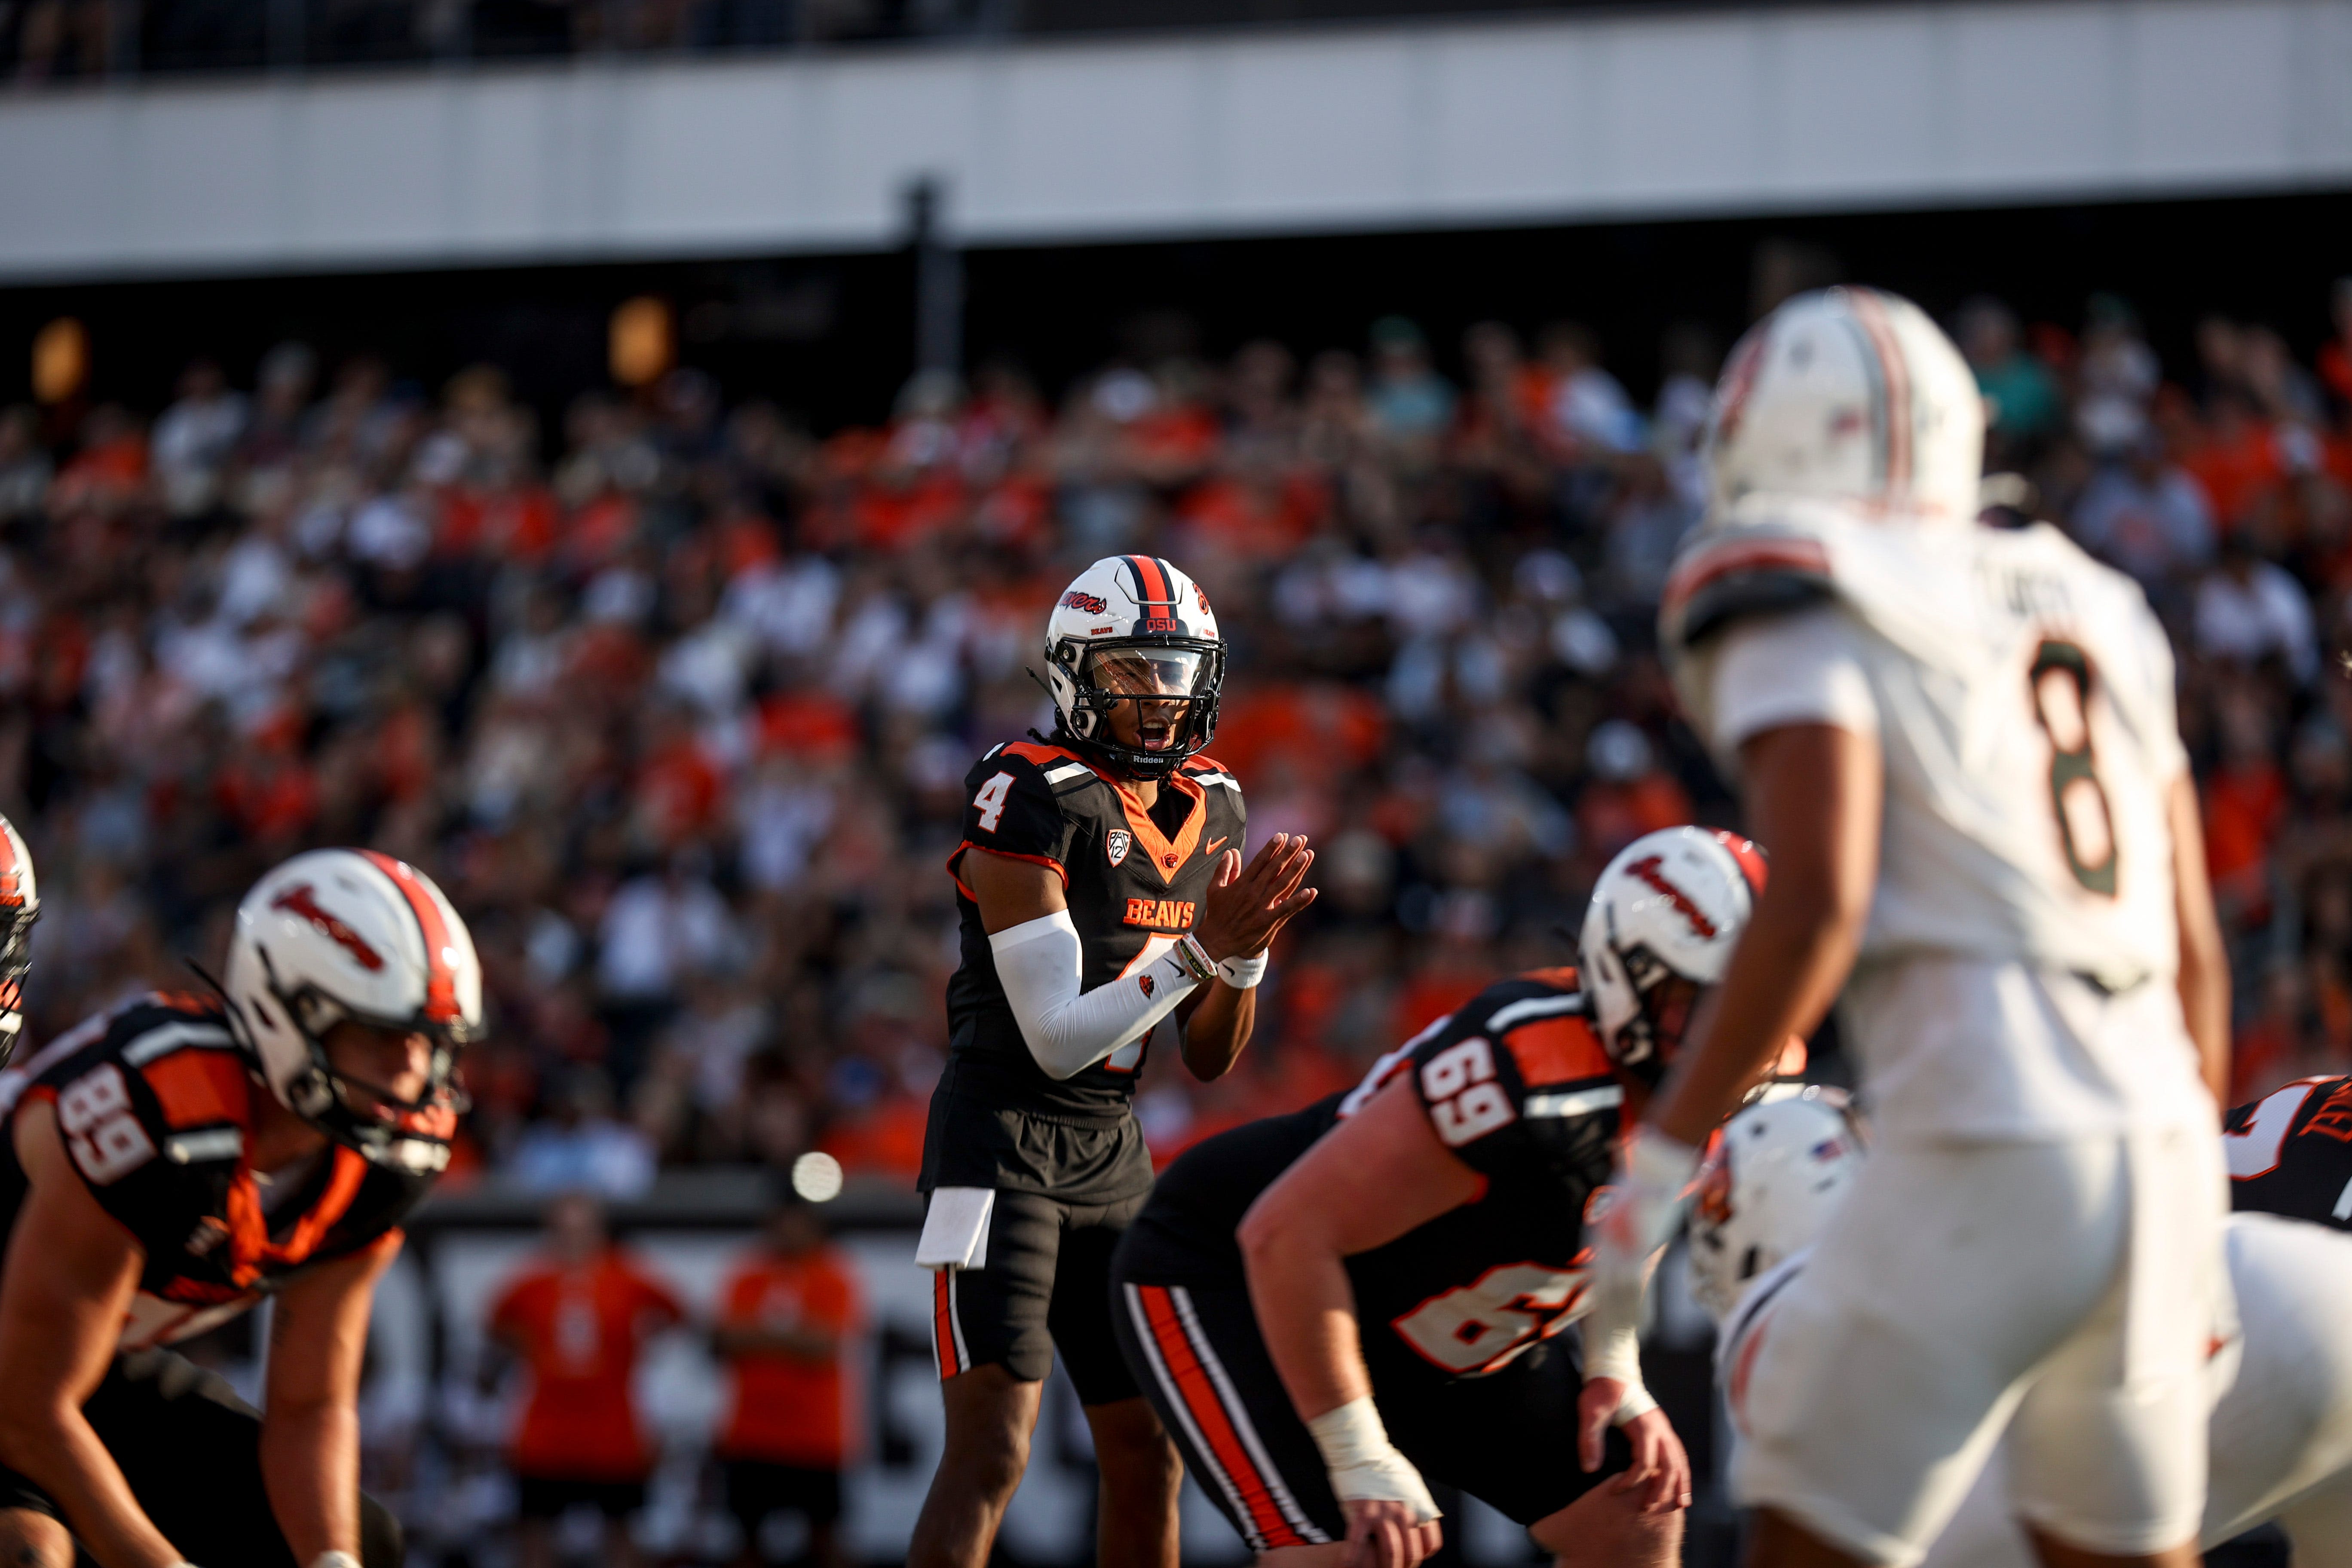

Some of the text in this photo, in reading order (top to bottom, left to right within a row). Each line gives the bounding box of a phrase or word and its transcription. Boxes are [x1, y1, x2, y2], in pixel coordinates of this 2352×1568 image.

[1091, 627, 1113, 635] BEAVS
[1146, 619, 1176, 631] OSU
[1133, 755, 1164, 763] Riddell
[2028, 637, 2119, 899] 8
[972, 770, 1017, 834] 4
[1109, 831, 1129, 852] PAC
[1111, 845, 1123, 858] 12
[1123, 898, 1195, 929] BEAVS
[1190, 940, 1206, 959] OREGON
[1420, 1035, 1518, 1148] 69
[58, 1060, 159, 1187] 89
